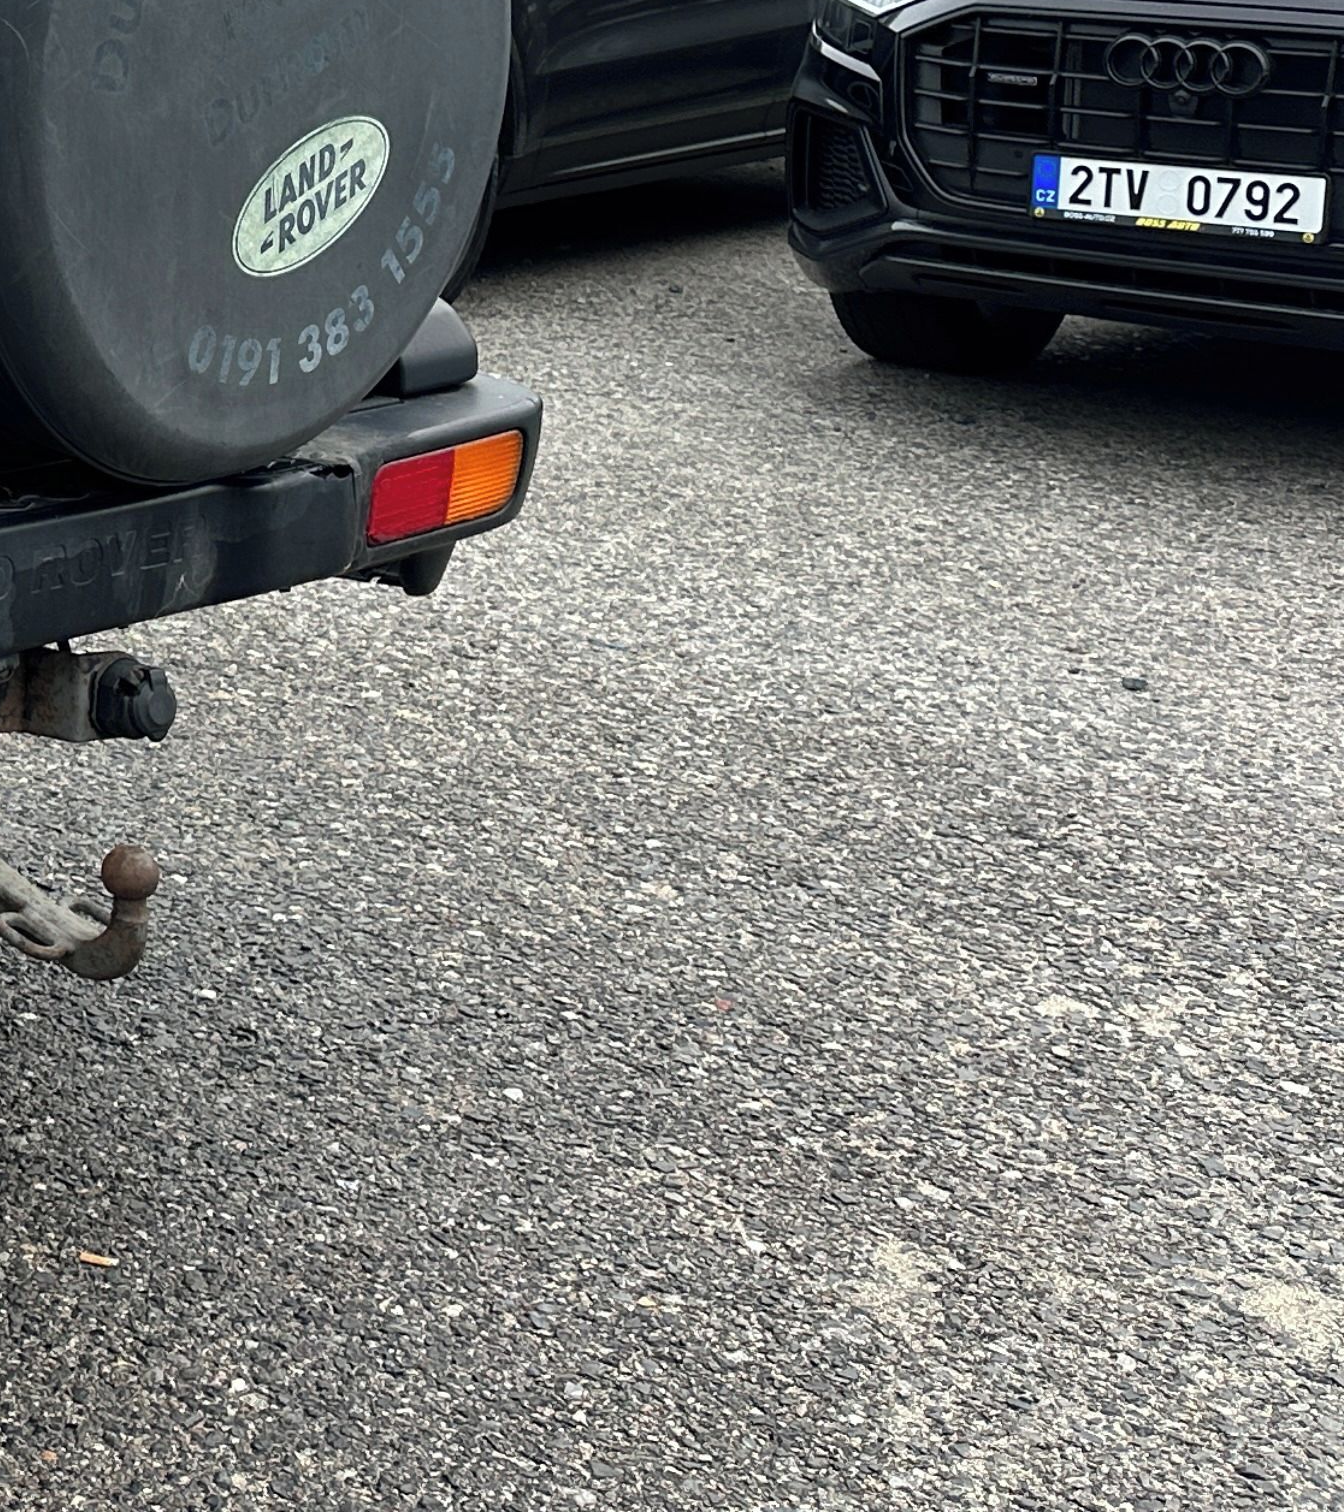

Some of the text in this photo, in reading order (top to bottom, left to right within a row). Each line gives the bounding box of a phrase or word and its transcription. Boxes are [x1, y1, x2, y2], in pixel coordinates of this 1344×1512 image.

[263, 142, 337, 225] LAND
[277, 157, 368, 254] ROVER
[1034, 186, 1057, 204] CZ
[1067, 164, 1303, 226] 2TV 0792
[1135, 216, 1168, 229] BOSS
[188, 324, 283, 386] 0191
[297, 284, 375, 373] 383
[30, 512, 208, 595] ROVER
